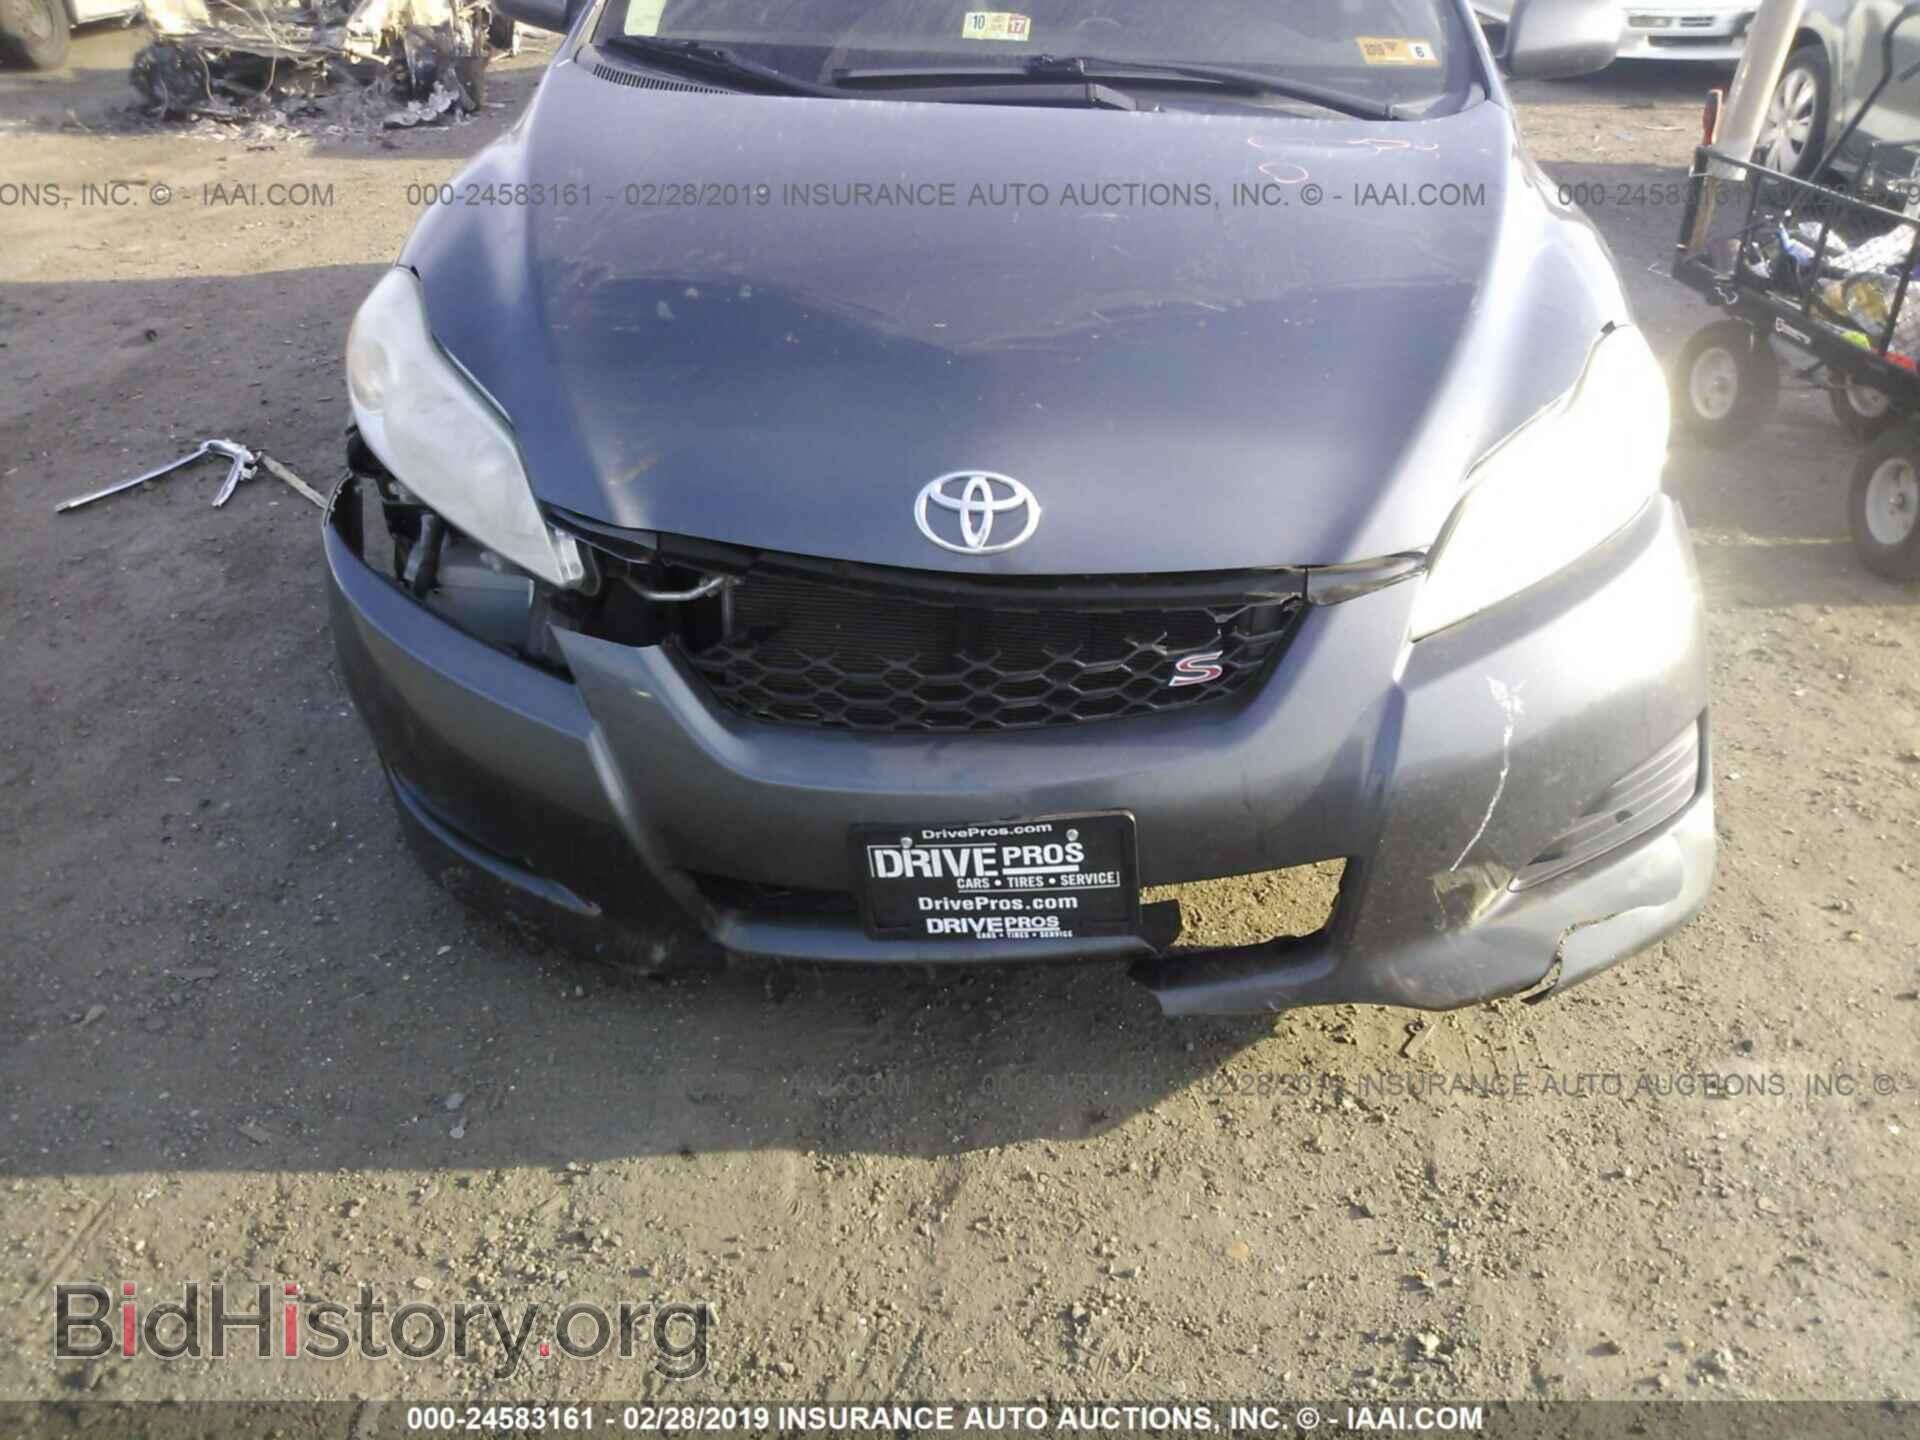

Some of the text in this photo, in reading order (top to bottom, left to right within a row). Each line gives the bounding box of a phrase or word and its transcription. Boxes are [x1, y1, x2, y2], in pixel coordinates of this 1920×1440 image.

[973, 14, 986, 30] 10
[1011, 20, 1022, 33] 17
[1168, 650, 1223, 687] S
[921, 824, 1053, 840] DrivePros.com
[874, 842, 1085, 878] DRIVE PROS
[956, 872, 1116, 889] CARS TIRES SERVICE
[918, 896, 1078, 911] DrivePros.com
